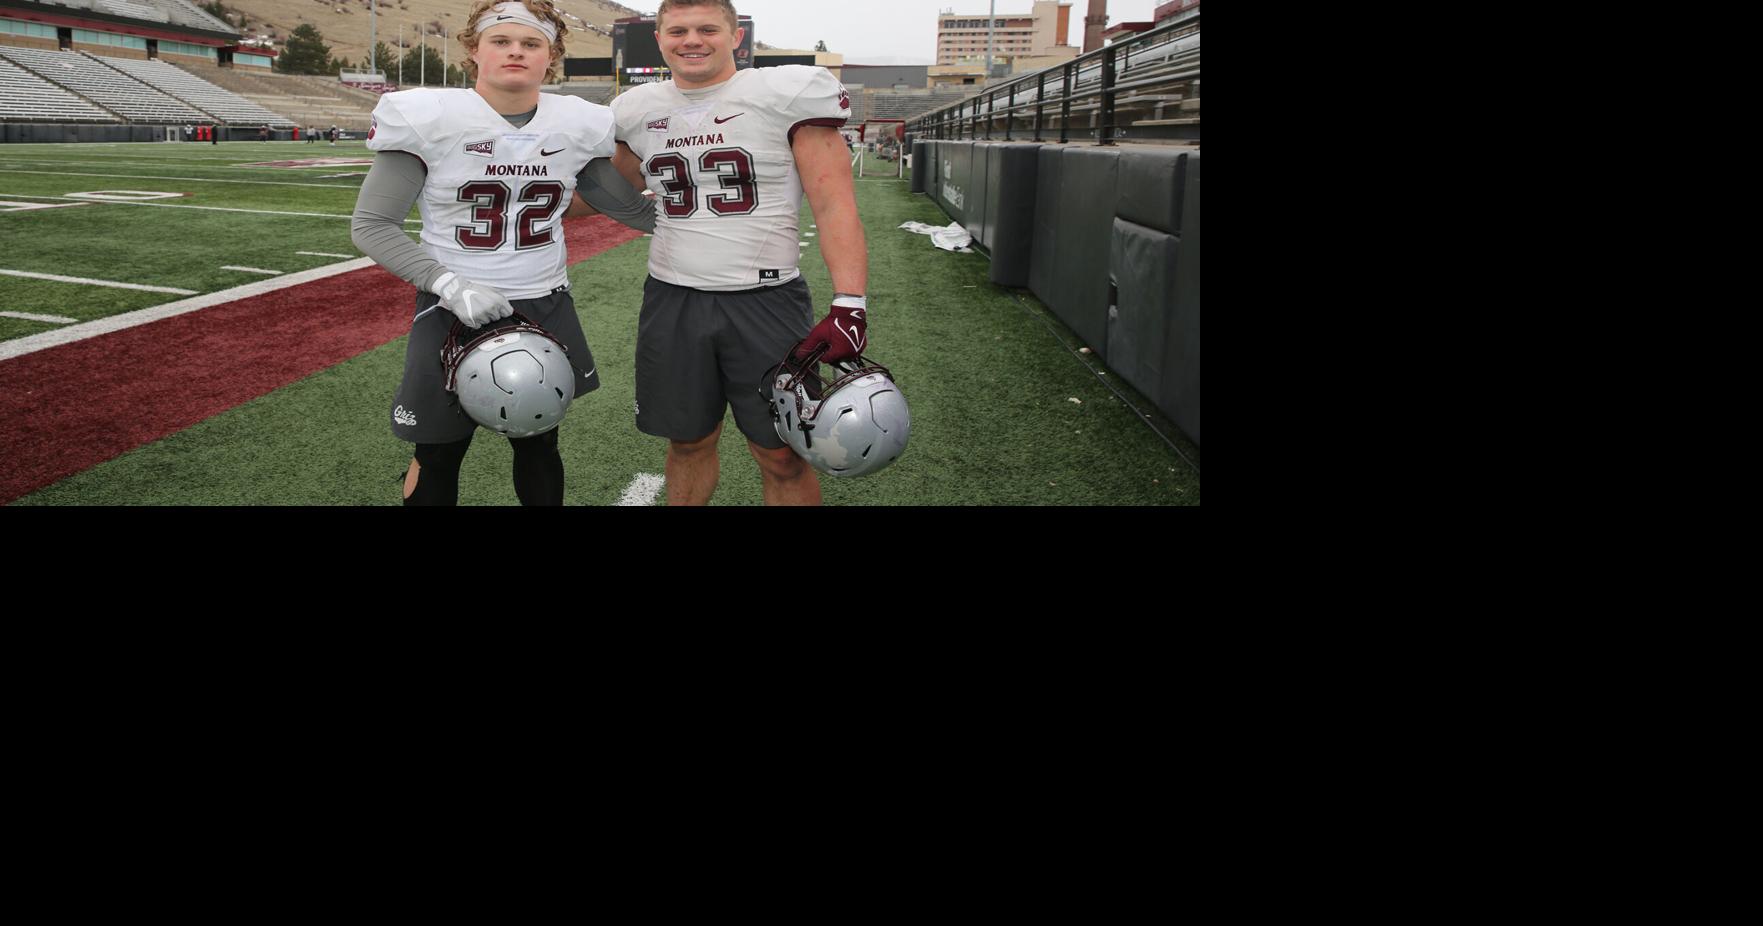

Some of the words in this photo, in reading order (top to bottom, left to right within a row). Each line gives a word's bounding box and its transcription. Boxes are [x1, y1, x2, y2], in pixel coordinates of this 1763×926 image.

[665, 133, 725, 149] MONTANA
[485, 165, 548, 176] MONTANA
[646, 147, 759, 218] 33
[455, 180, 565, 251] 32
